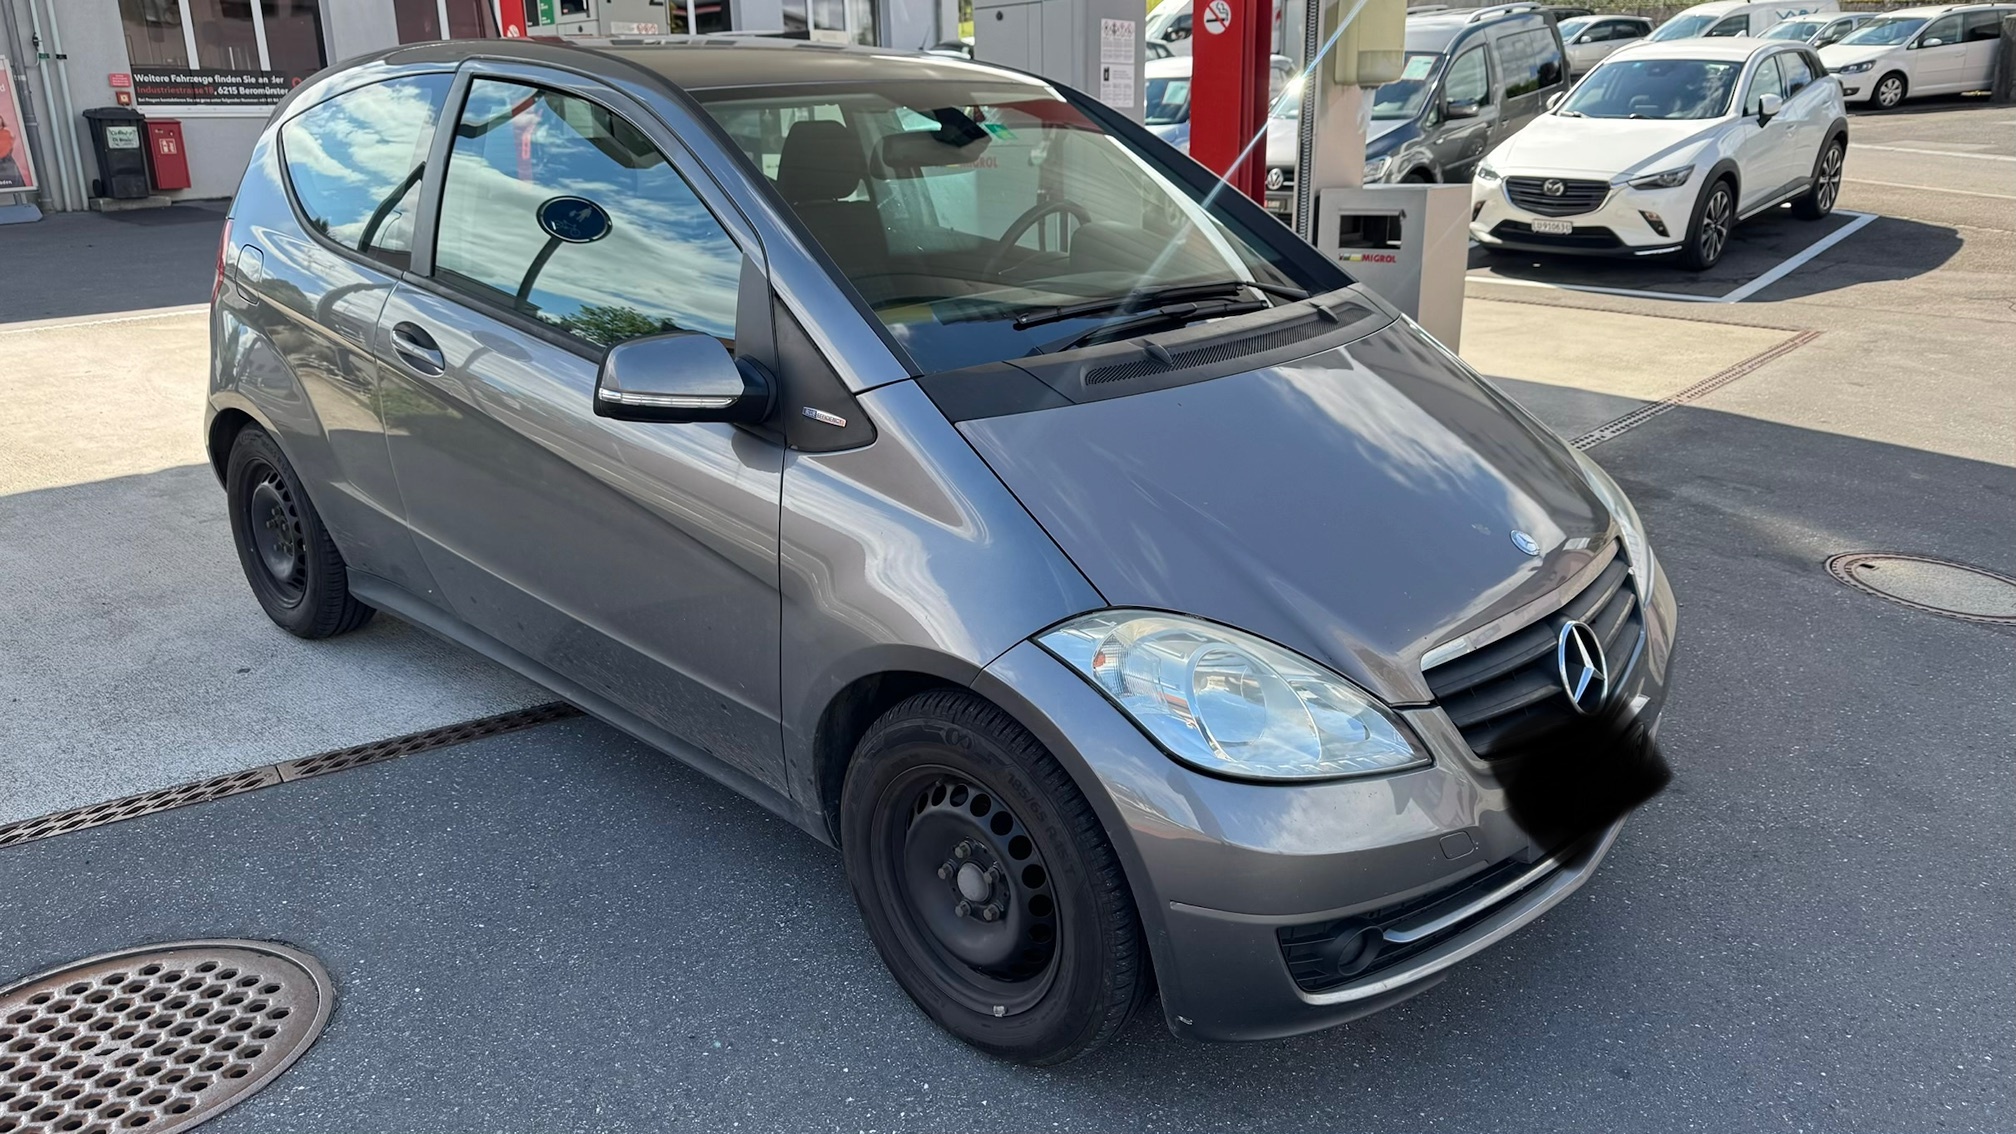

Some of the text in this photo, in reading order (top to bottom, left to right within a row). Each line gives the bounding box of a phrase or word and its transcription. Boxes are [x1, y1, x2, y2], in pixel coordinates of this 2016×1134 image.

[133, 74, 169, 83] Weitere
[214, 74, 242, 84] finden
[243, 75, 256, 84] Sie
[258, 76, 269, 84] an
[218, 86, 238, 95] 6215
[239, 86, 289, 95] Beromünster
[1361, 253, 1397, 263] MIGROL
[1006, 773, 1048, 823] 185/65
